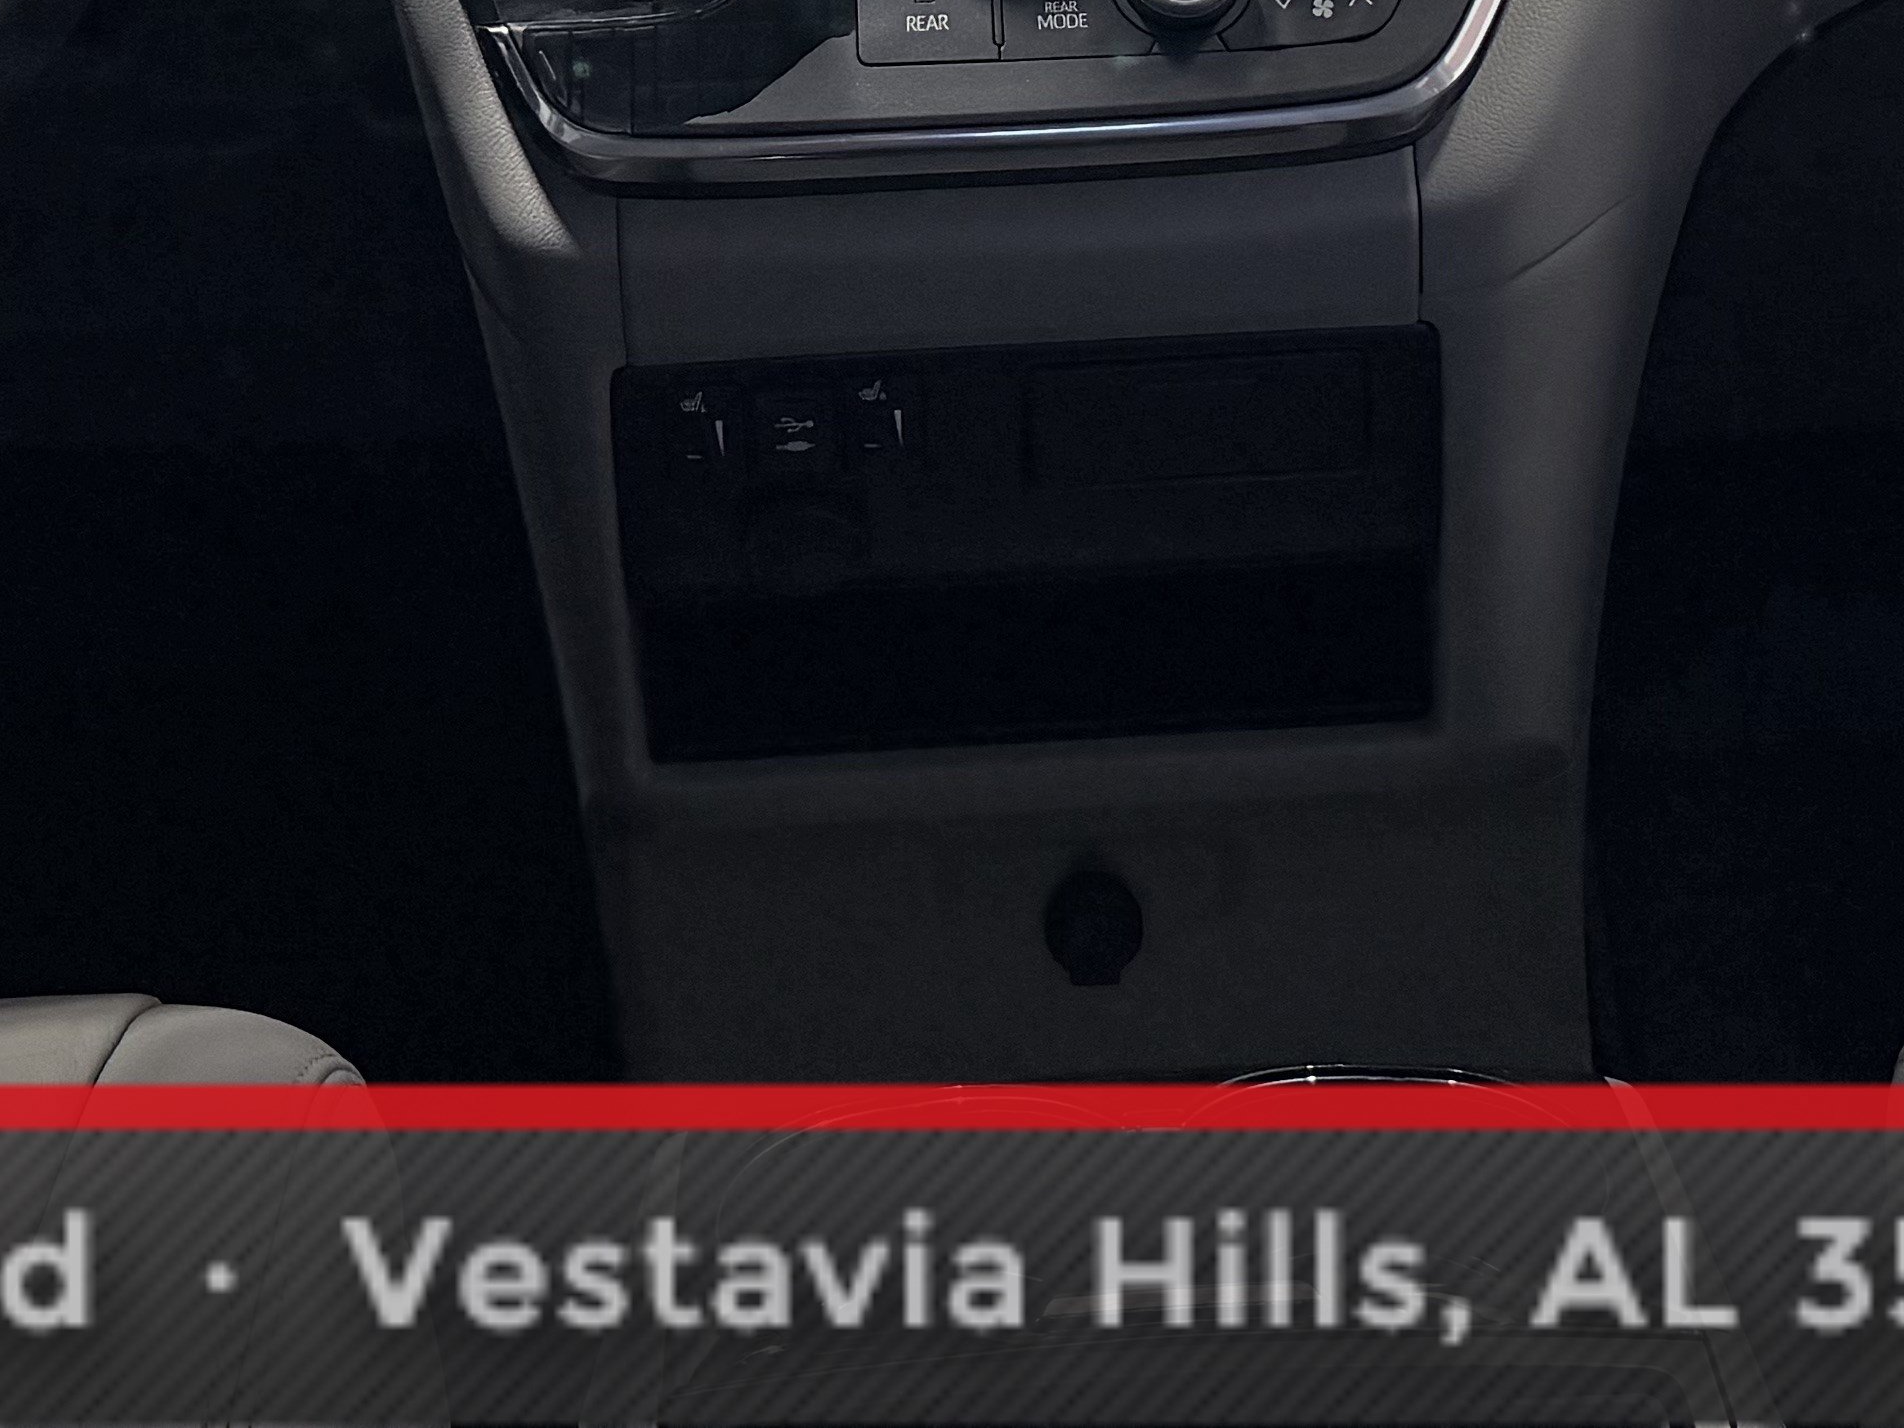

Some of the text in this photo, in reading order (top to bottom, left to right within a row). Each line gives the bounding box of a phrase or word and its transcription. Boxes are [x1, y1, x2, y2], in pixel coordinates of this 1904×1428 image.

[1044, 0, 1079, 13] REAR
[905, 13, 950, 33] REAR
[1036, 13, 1089, 31] MODE
